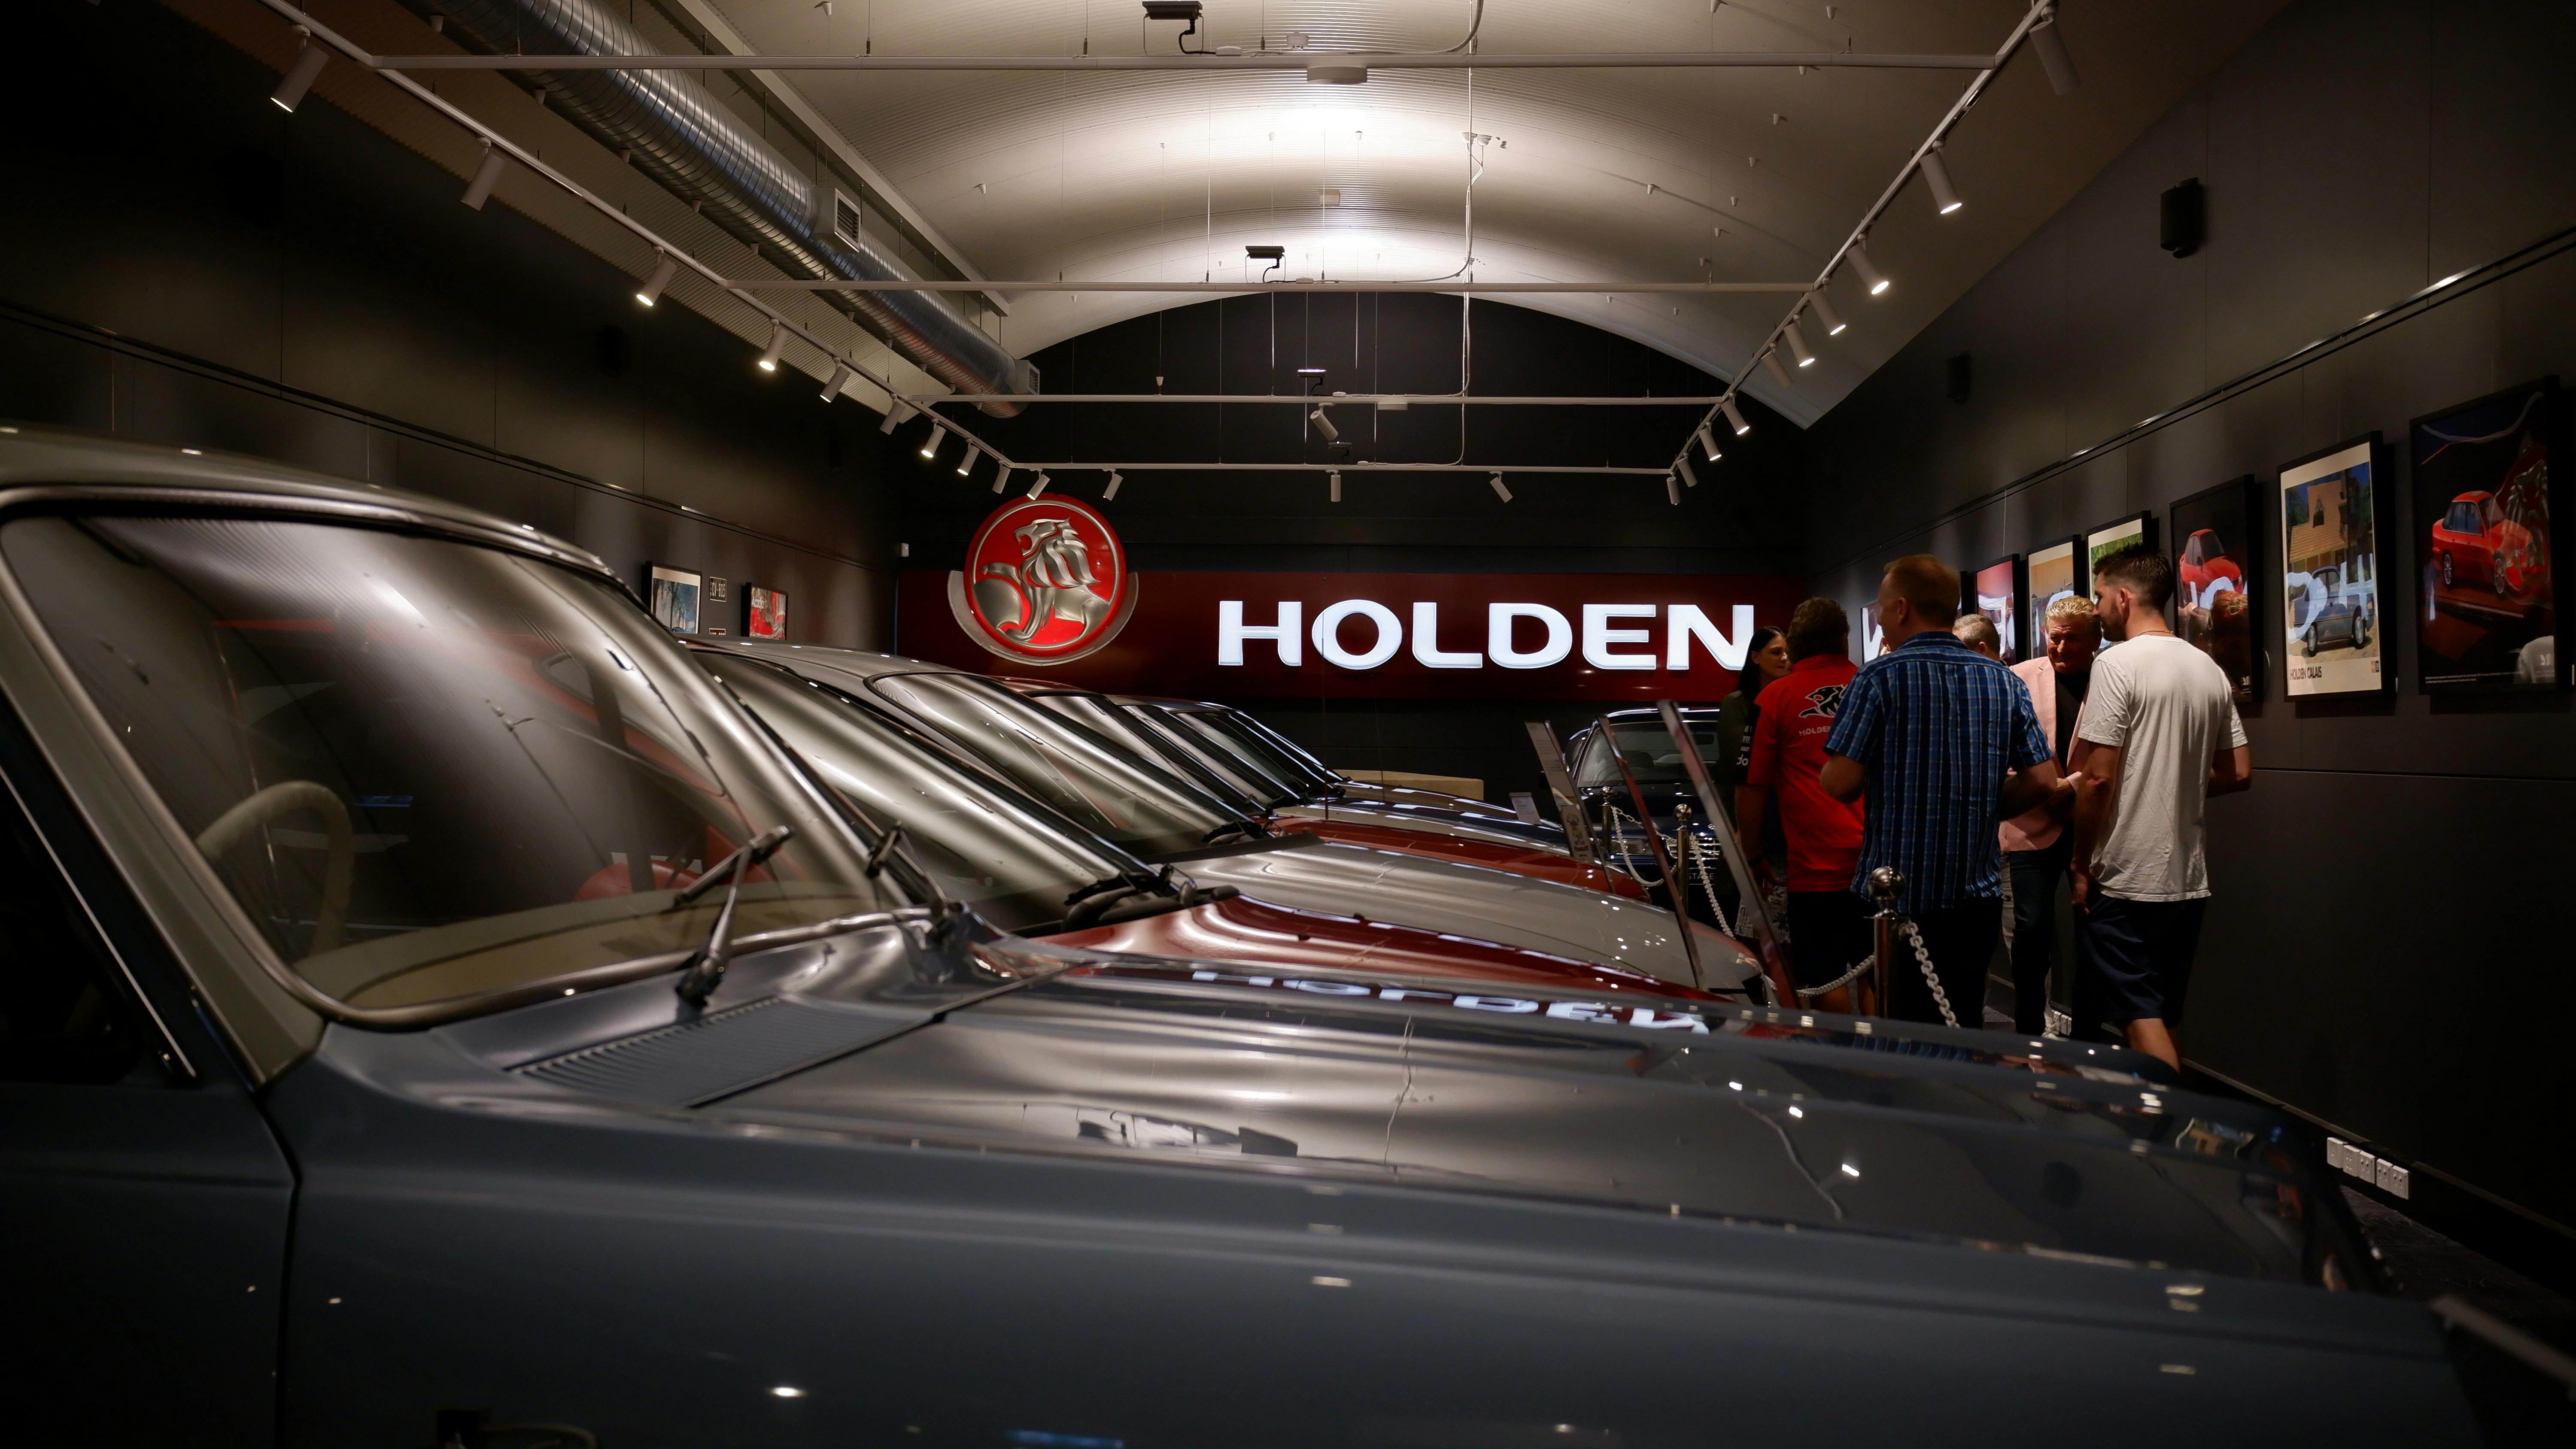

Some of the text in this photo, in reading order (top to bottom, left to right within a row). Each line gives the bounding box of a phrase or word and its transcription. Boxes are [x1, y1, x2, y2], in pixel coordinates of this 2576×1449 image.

[1218, 599, 1754, 670] HOLDEN
[2290, 666, 2322, 680] HOLDEN CALAIS
[1798, 726, 1831, 736] HOLDE
